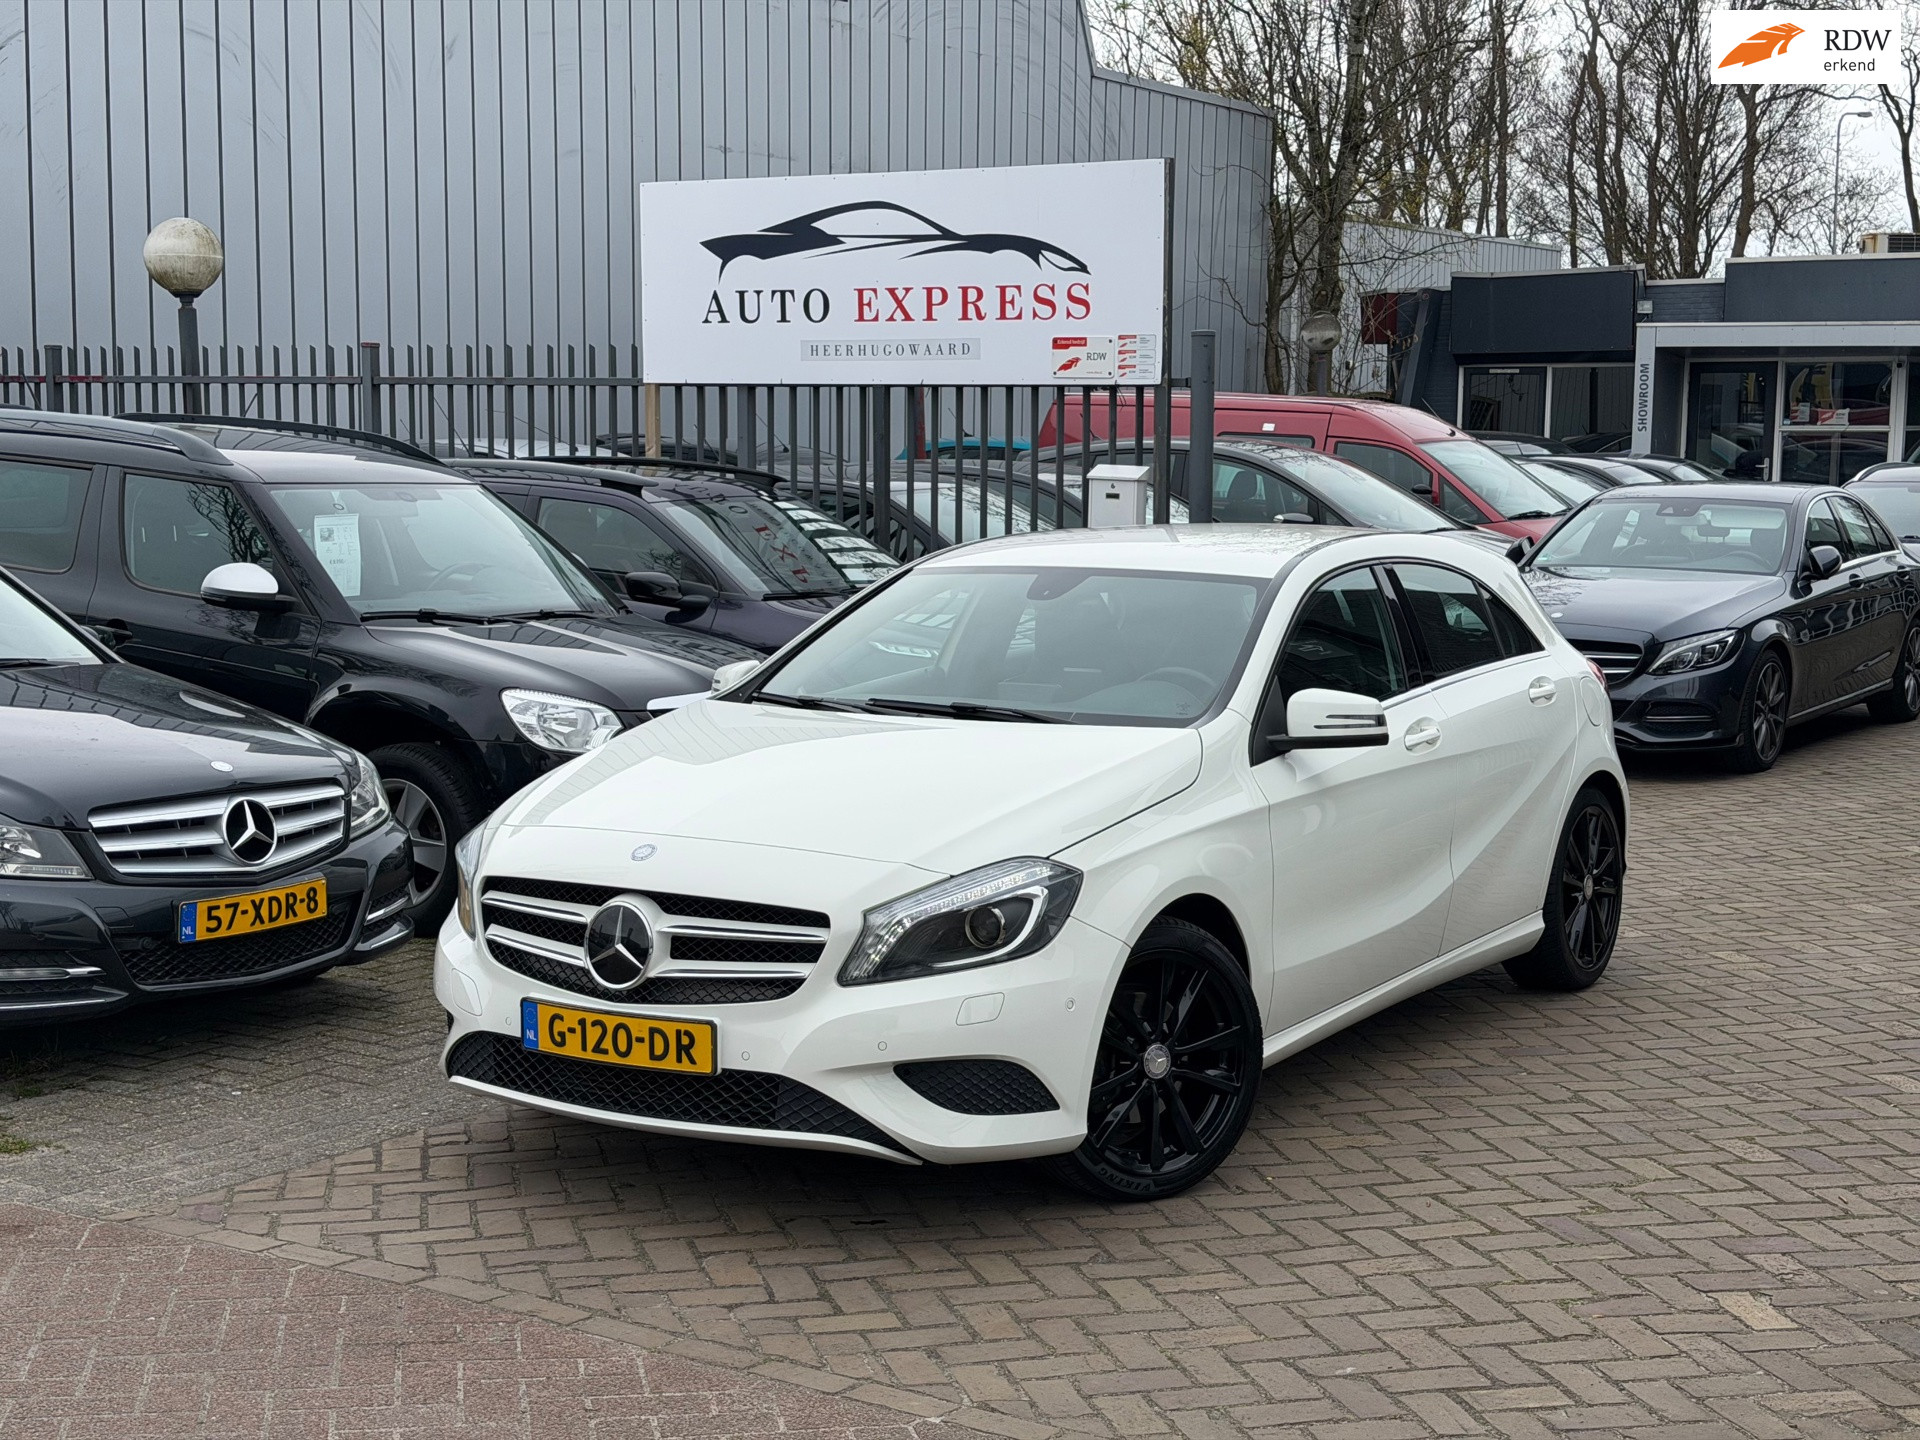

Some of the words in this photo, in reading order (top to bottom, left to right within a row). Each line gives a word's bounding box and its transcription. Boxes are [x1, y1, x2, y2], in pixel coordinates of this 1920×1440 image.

[702, 288, 831, 324] AUTO
[854, 283, 1092, 322] EXPRESS
[810, 342, 971, 357] HEERHUGOWAARD
[1086, 352, 1107, 361] RDW
[1637, 363, 1649, 432] SHOWROOM
[205, 886, 319, 933] 57-XDR-8
[182, 926, 194, 935] NL
[526, 1029, 537, 1041] NL
[548, 1012, 697, 1065] G-120-DR
